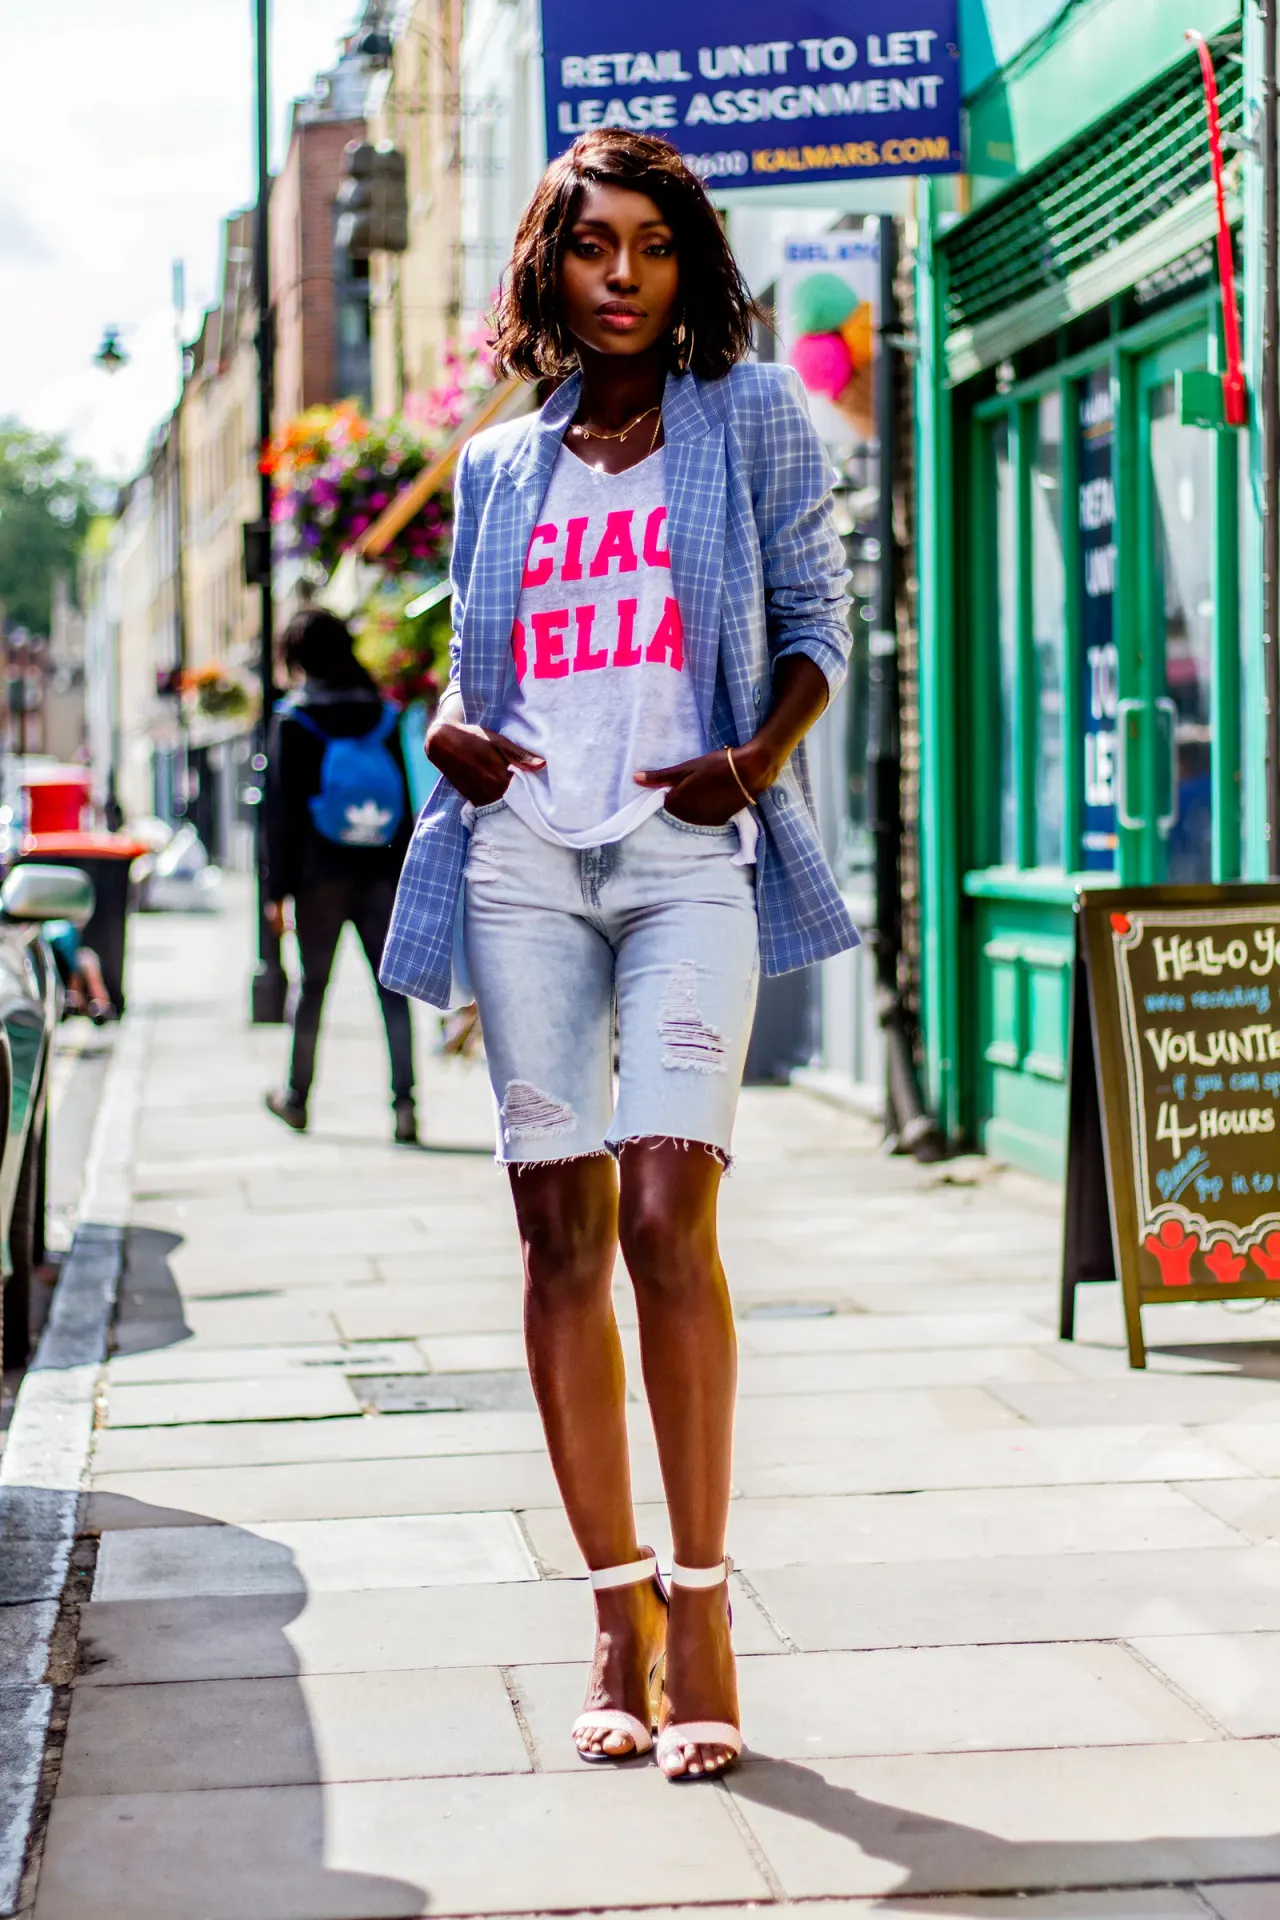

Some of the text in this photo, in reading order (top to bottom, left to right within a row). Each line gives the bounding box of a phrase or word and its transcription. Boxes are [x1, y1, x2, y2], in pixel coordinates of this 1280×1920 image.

[561, 30, 938, 88] RETAIL UNIT TO LET
[558, 75, 945, 134] LEASE ASSIGNMENT
[752, 136, 949, 173] KALMARS.COM
[1152, 934, 1248, 981] HELLO
[1156, 1101, 1275, 1159] 4 HOURS
[1231, 1172, 1249, 1194] in
[1252, 1171, 1273, 1192] to
